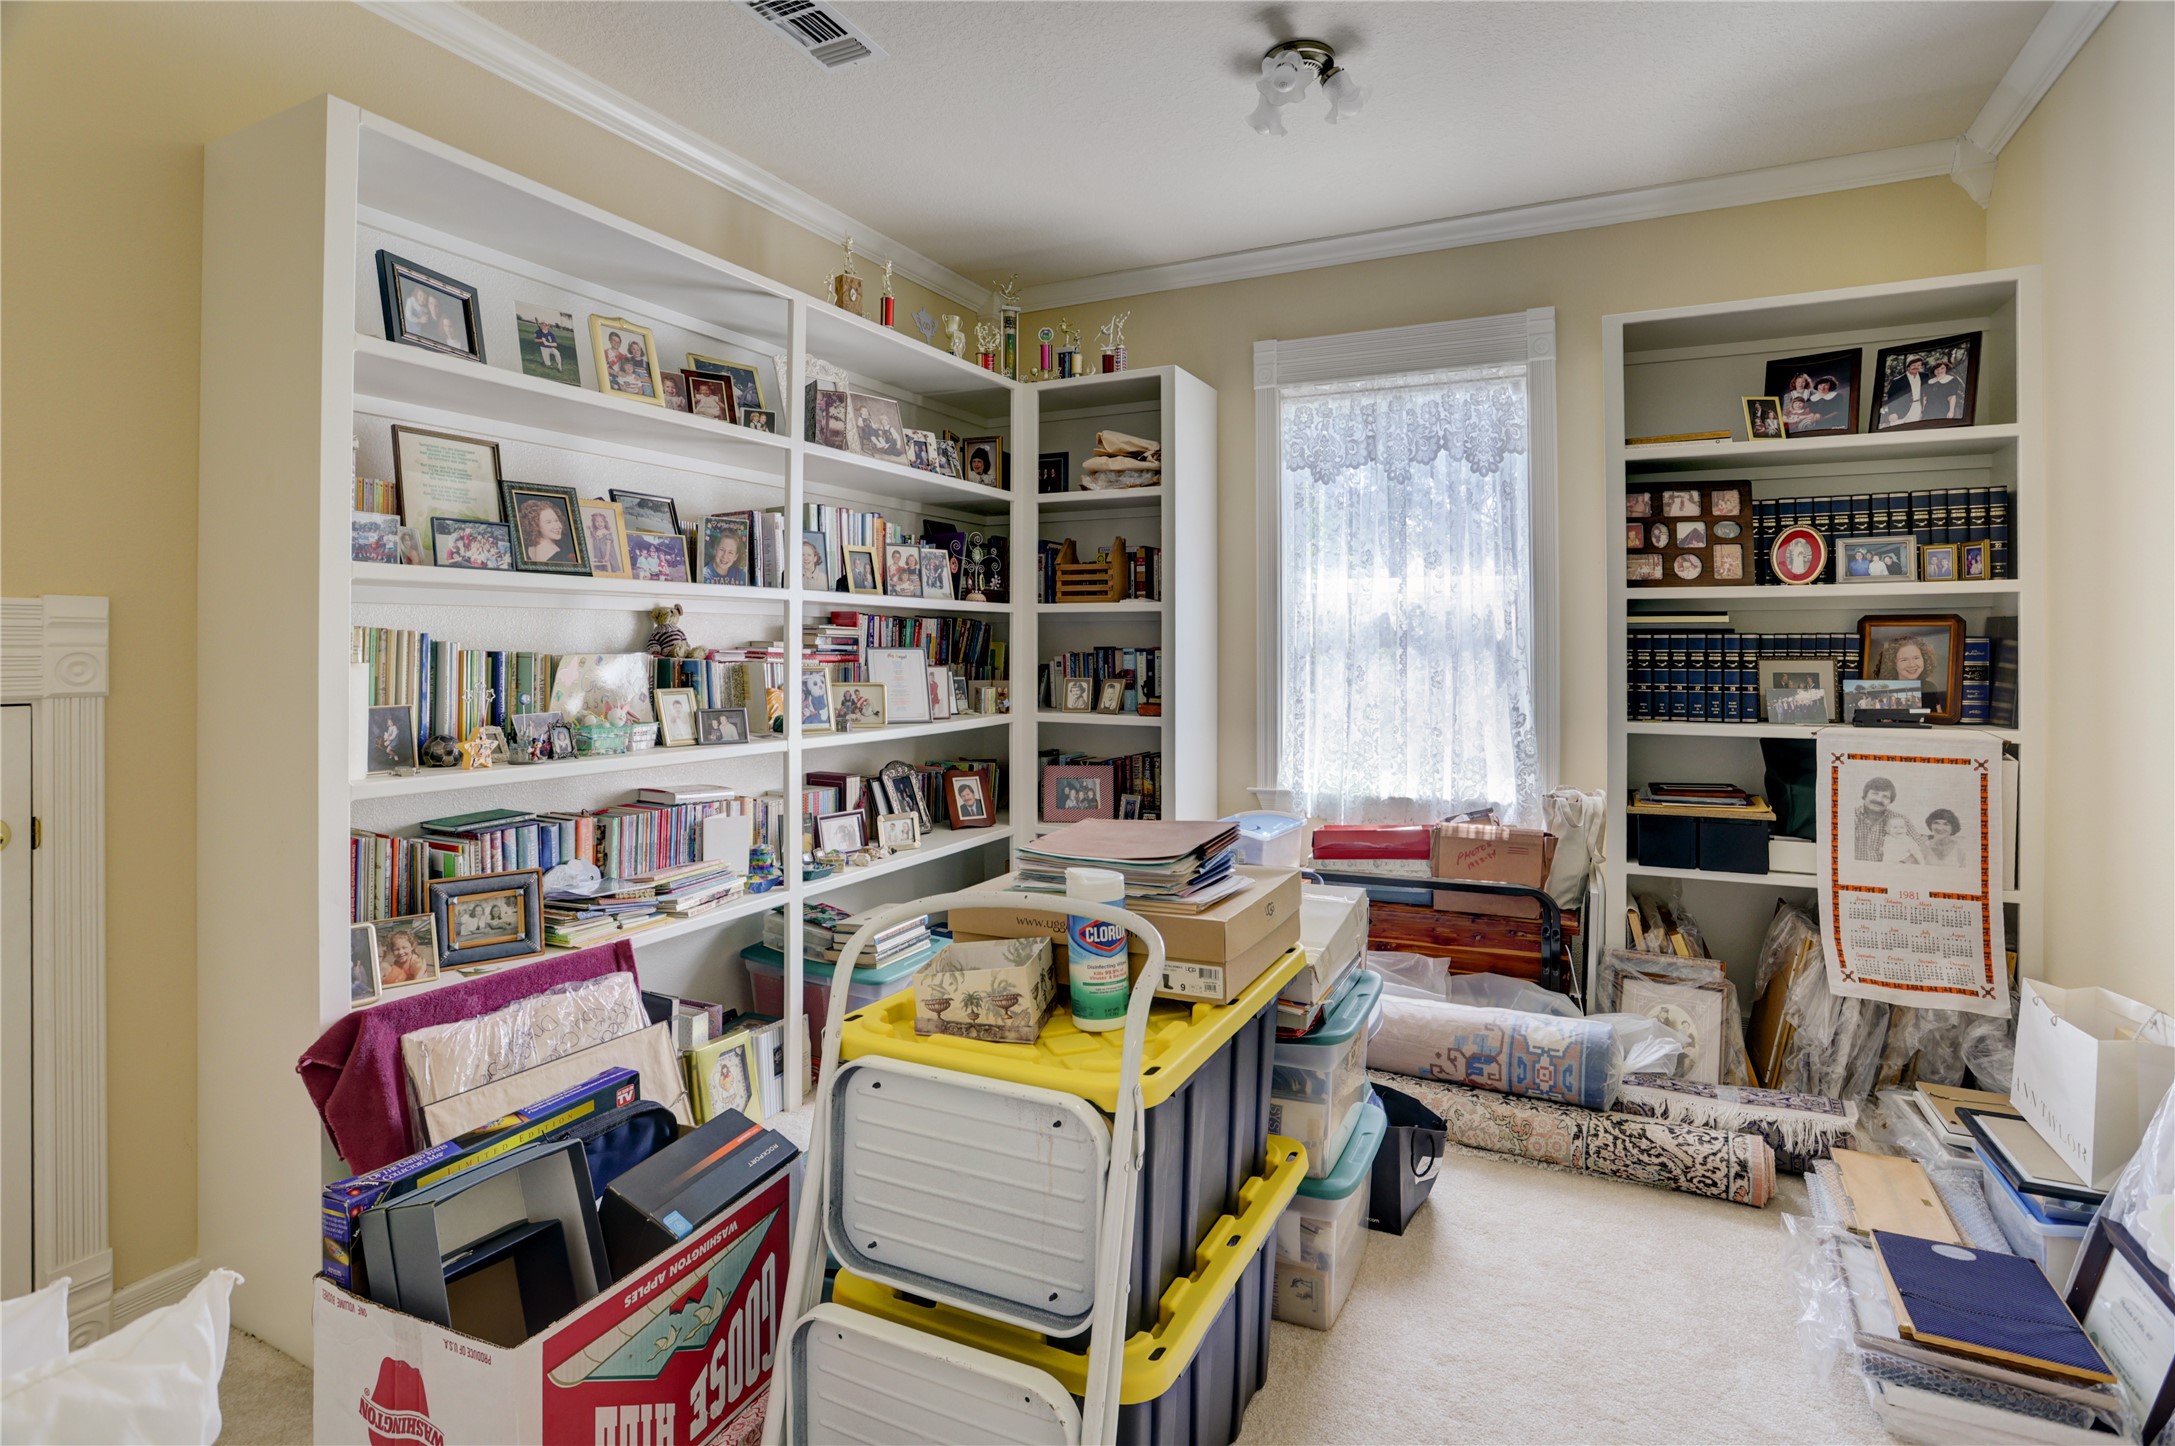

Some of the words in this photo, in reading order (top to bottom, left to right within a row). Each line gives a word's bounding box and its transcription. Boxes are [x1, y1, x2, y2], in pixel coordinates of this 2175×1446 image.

[1456, 840, 1494, 866] PHOTOS
[1899, 890, 1920, 900] 1981
[1087, 962, 1116, 970] Disinfecting
[1180, 983, 1186, 991] 9
[617, 1092, 633, 1105] TV
[2013, 1076, 2038, 1108] ANN
[2040, 1100, 2087, 1163] TAYLOR
[447, 1143, 508, 1176] LIMITED
[519, 1113, 573, 1142] EDITION
[747, 1143, 779, 1168] ROCKPORT
[382, 1158, 428, 1181] COLLECTOR'S
[429, 1151, 444, 1161] MAP
[383, 1164, 400, 1175] THE
[399, 1152, 427, 1168] UNITED
[426, 1143, 448, 1157] STATES
[669, 1220, 738, 1278] WASHINGTON
[624, 1273, 667, 1309] APPLES
[458, 1344, 466, 1356] OF
[466, 1347, 492, 1366] PRODUCE
[690, 1251, 776, 1442] GOOSE
[358, 1396, 446, 1446] WASHINGTON
